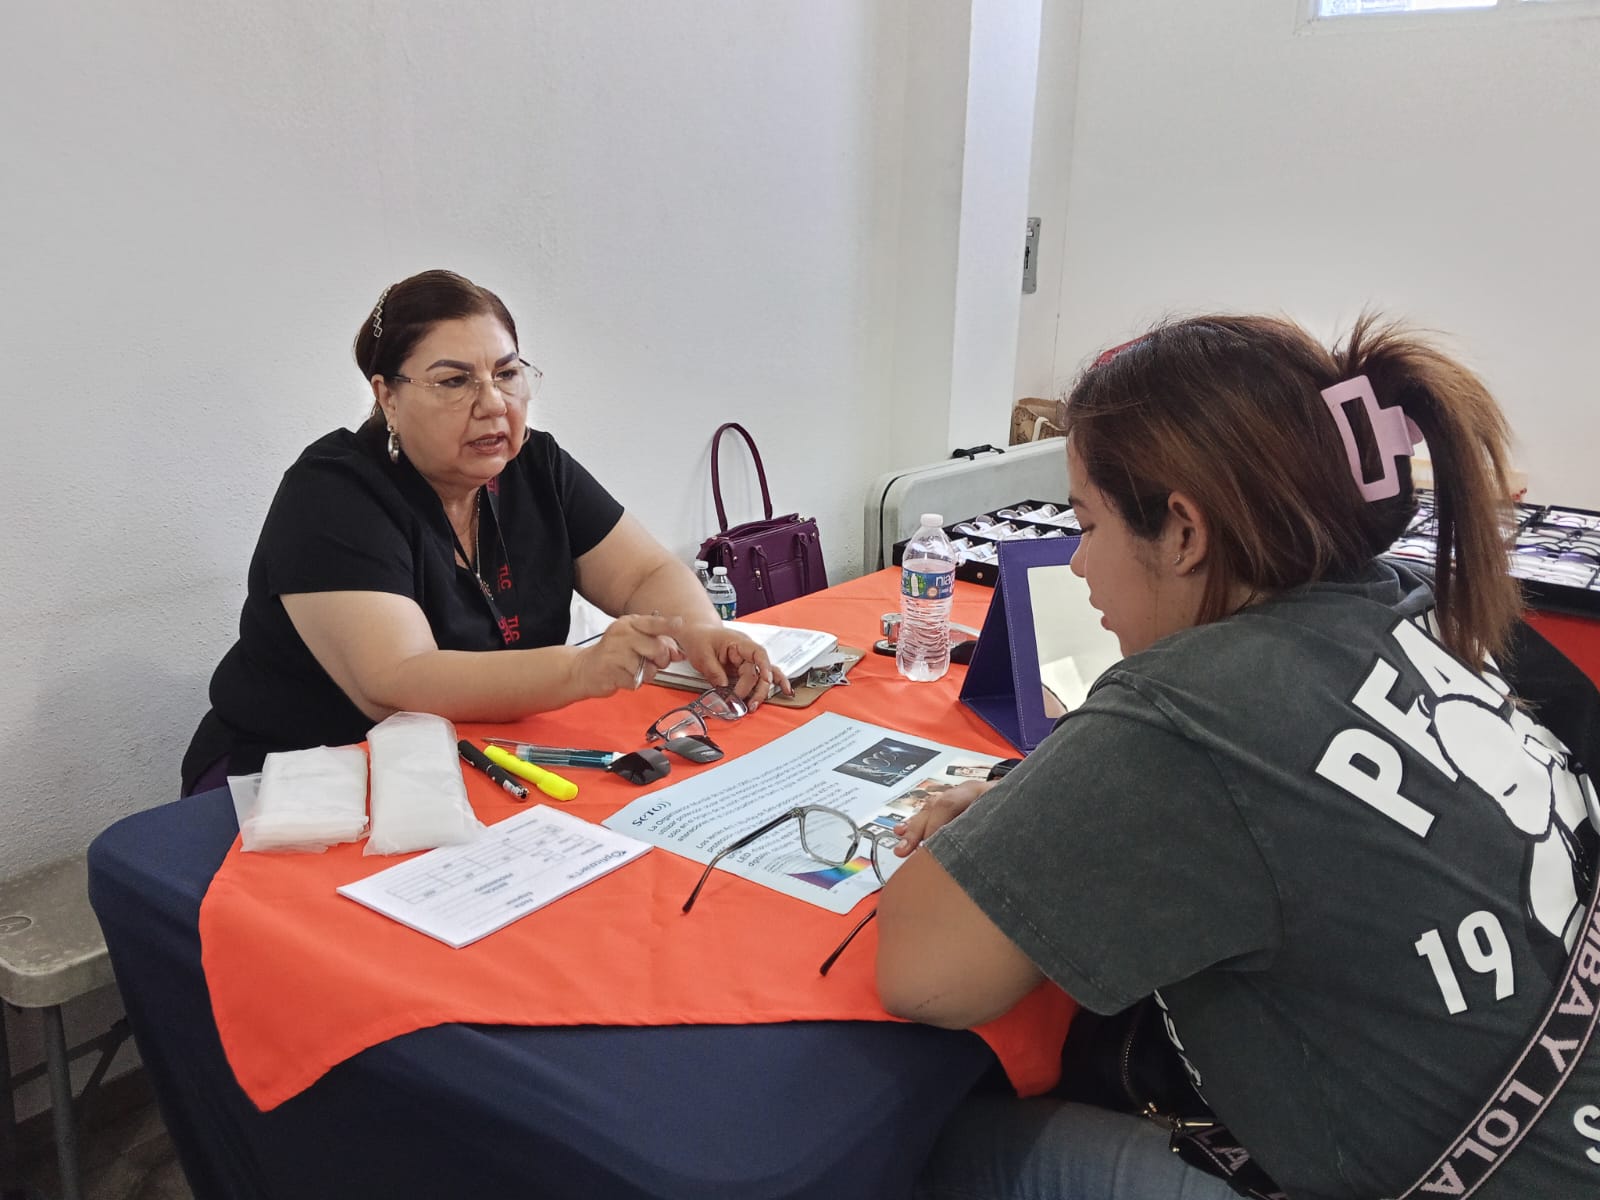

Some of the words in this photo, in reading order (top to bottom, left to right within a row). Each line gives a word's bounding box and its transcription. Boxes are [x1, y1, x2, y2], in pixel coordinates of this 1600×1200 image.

[500, 564, 512, 590] TLC
[1415, 910, 1514, 1015] 19
[1539, 1034, 1579, 1073] Y
[1420, 1079, 1544, 1195] LOLA
